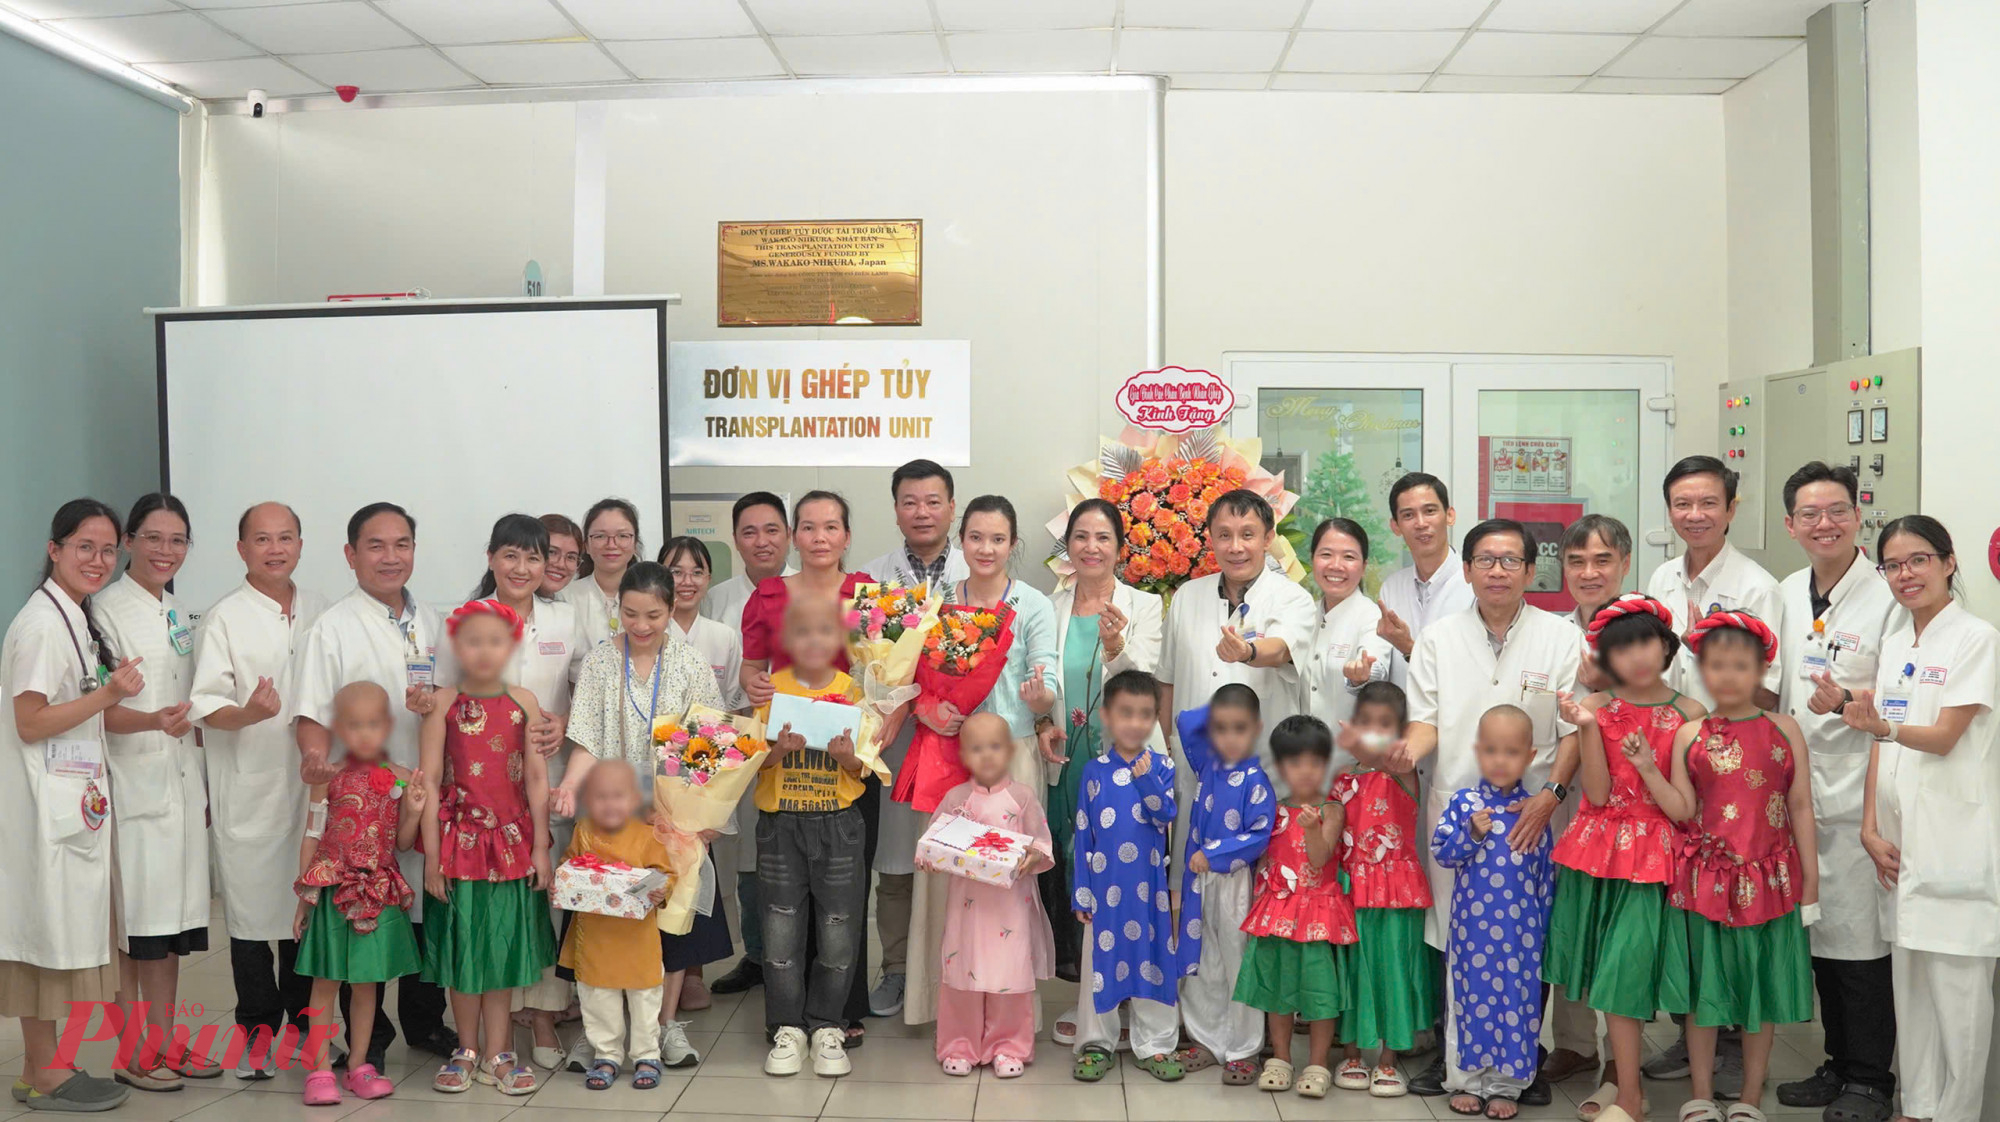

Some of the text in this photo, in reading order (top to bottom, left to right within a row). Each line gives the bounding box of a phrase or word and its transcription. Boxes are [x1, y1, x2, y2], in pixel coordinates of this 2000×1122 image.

[770, 228, 792, 236] GHÉP
[761, 236, 796, 244] WAKAKO
[775, 243, 852, 251] TRANSPLANTATION
[858, 258, 887, 268] Japan
[527, 280, 541, 297] 510
[703, 359, 931, 405] ĐƠN VỊ GHÉP TỦY
[1177, 406, 1214, 423] Tặng
[1265, 395, 1421, 432] Merry Christmas
[705, 416, 933, 438] TRANSPLANTATION UNIT
[1537, 542, 1558, 556] CC
